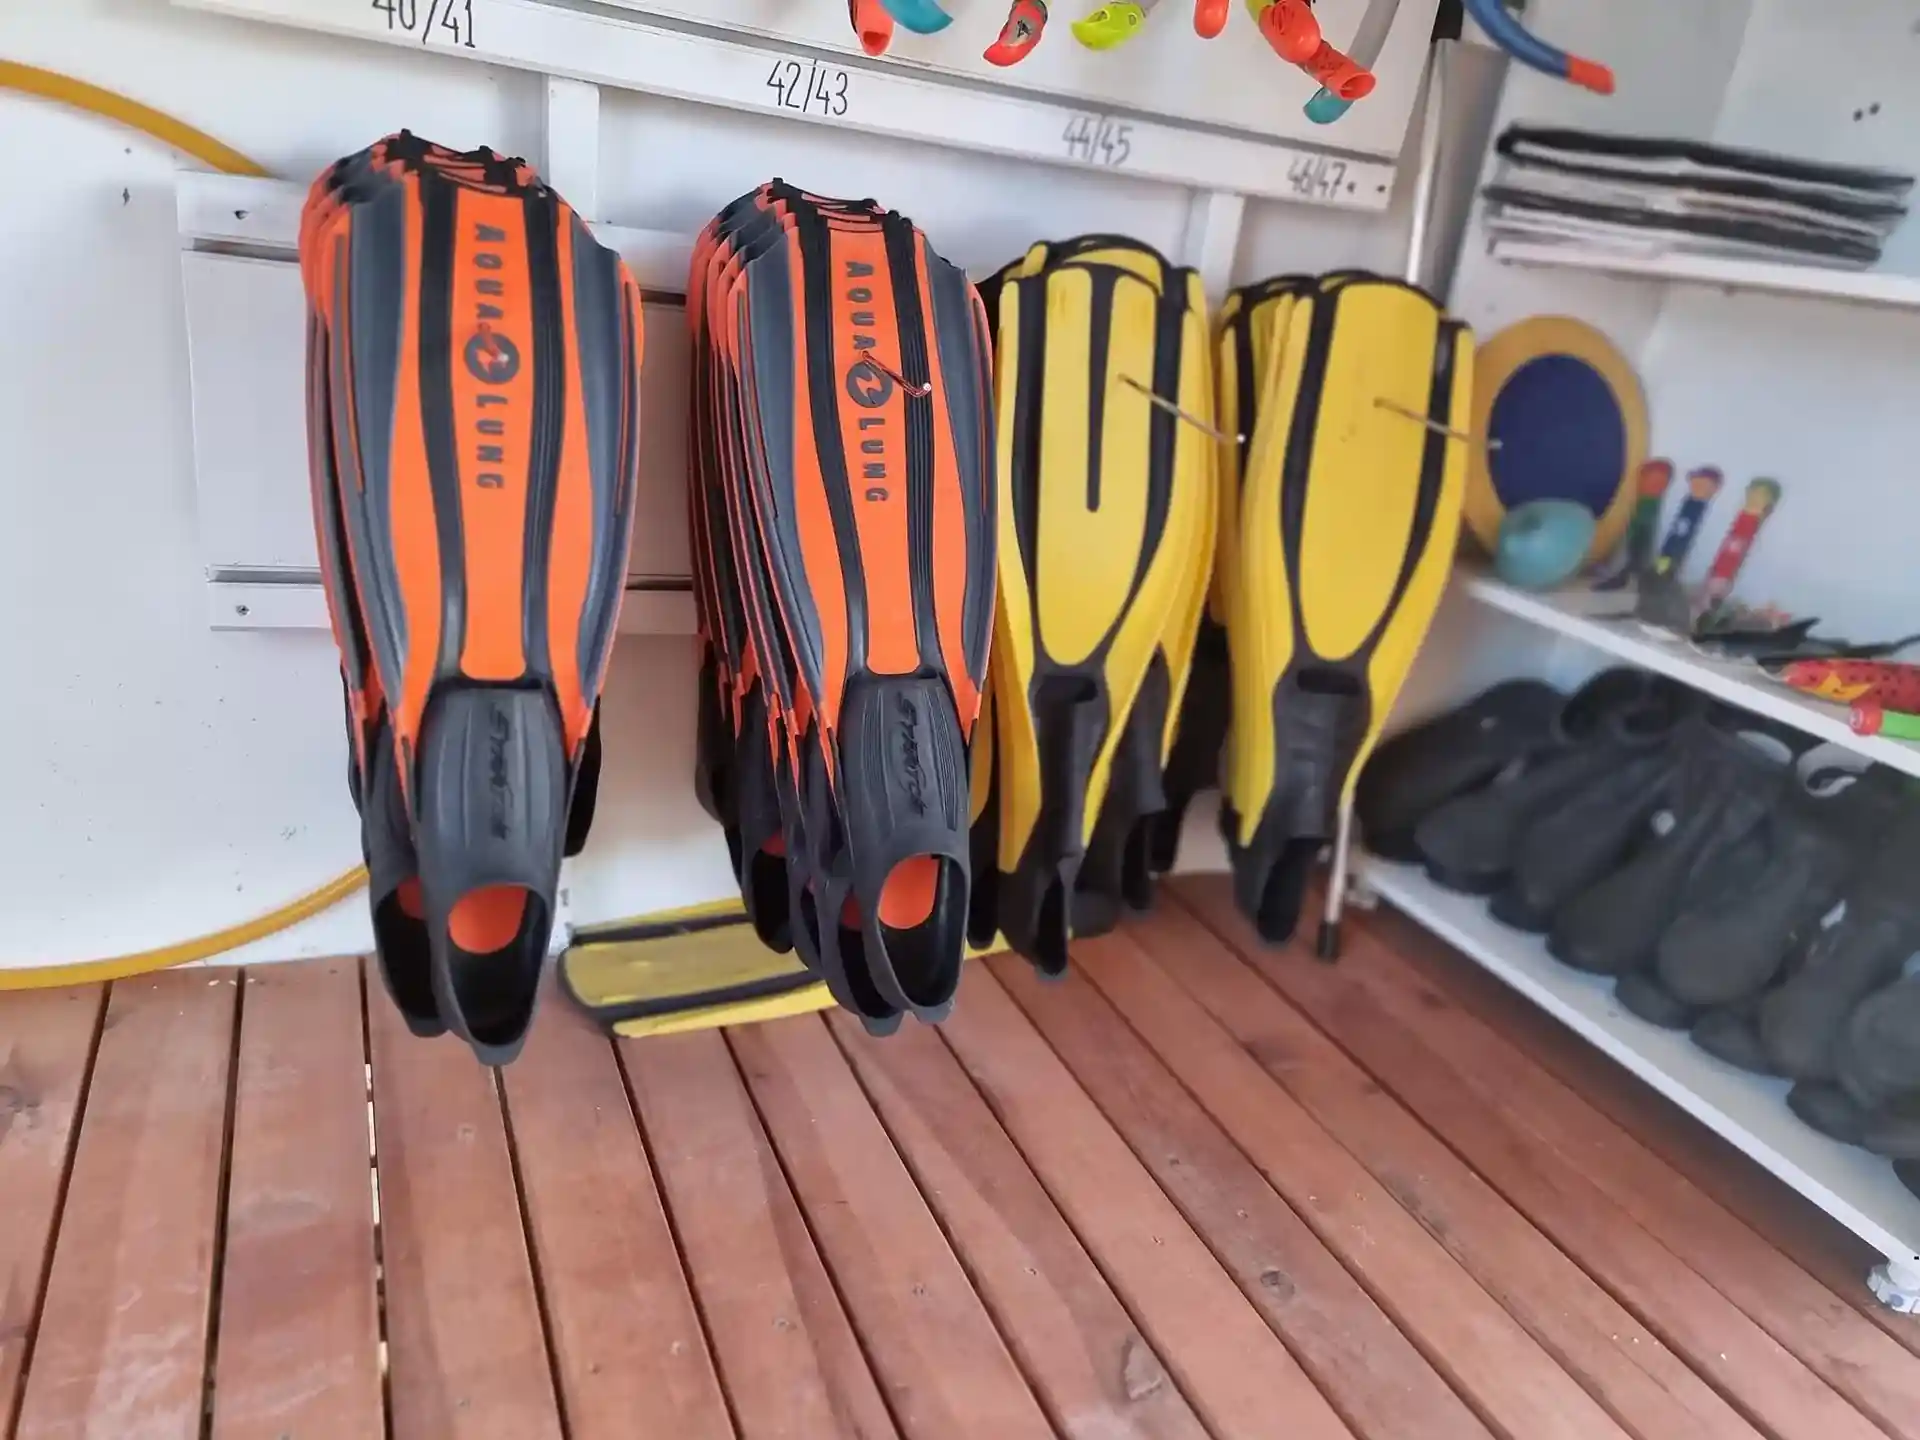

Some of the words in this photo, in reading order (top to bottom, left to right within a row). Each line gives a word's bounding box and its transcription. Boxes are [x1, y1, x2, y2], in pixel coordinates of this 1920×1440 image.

[372, 0, 475, 48] 40/41
[767, 58, 848, 116] 42/43
[1062, 115, 1134, 166] 44/45
[1287, 155, 1347, 200] 46/47
[474, 223, 506, 321] AQUA
[845, 261, 876, 351] AQUA
[475, 393, 508, 489] LUNG
[859, 417, 889, 502] LUNG
